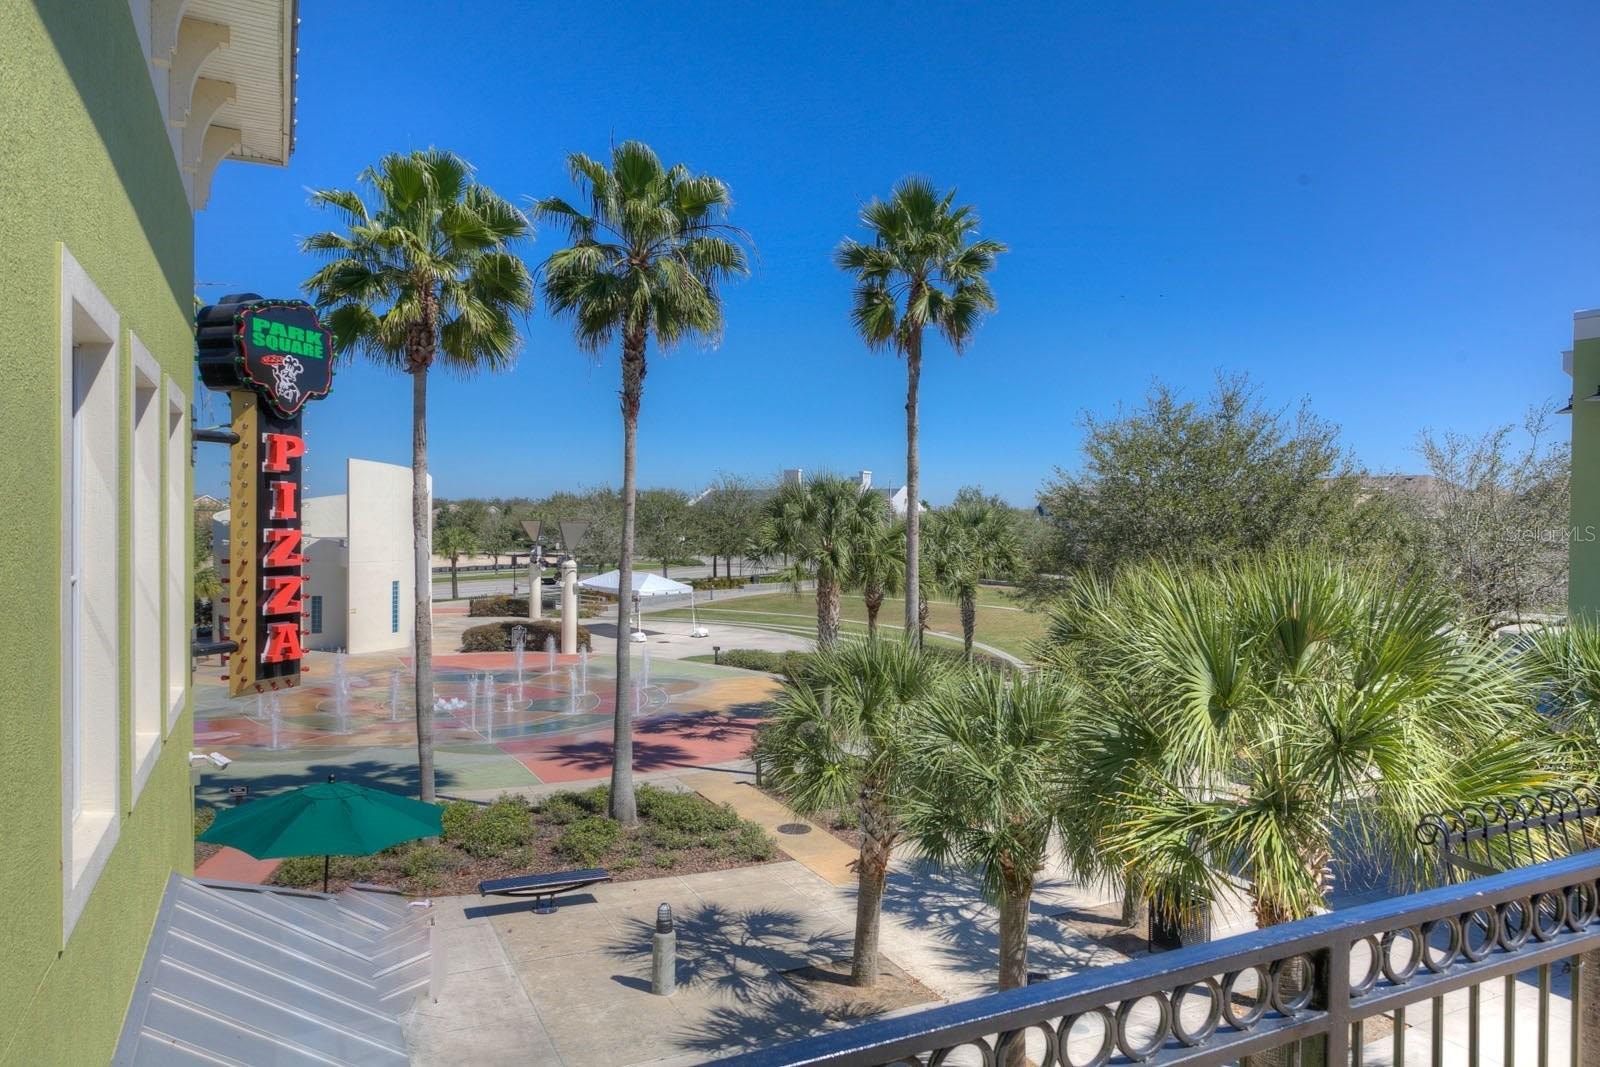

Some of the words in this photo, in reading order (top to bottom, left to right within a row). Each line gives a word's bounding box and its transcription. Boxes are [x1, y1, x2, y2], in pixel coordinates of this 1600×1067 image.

[251, 317, 322, 344] PARK
[251, 332, 323, 360] SQUARE
[261, 432, 305, 664] PIZZA
